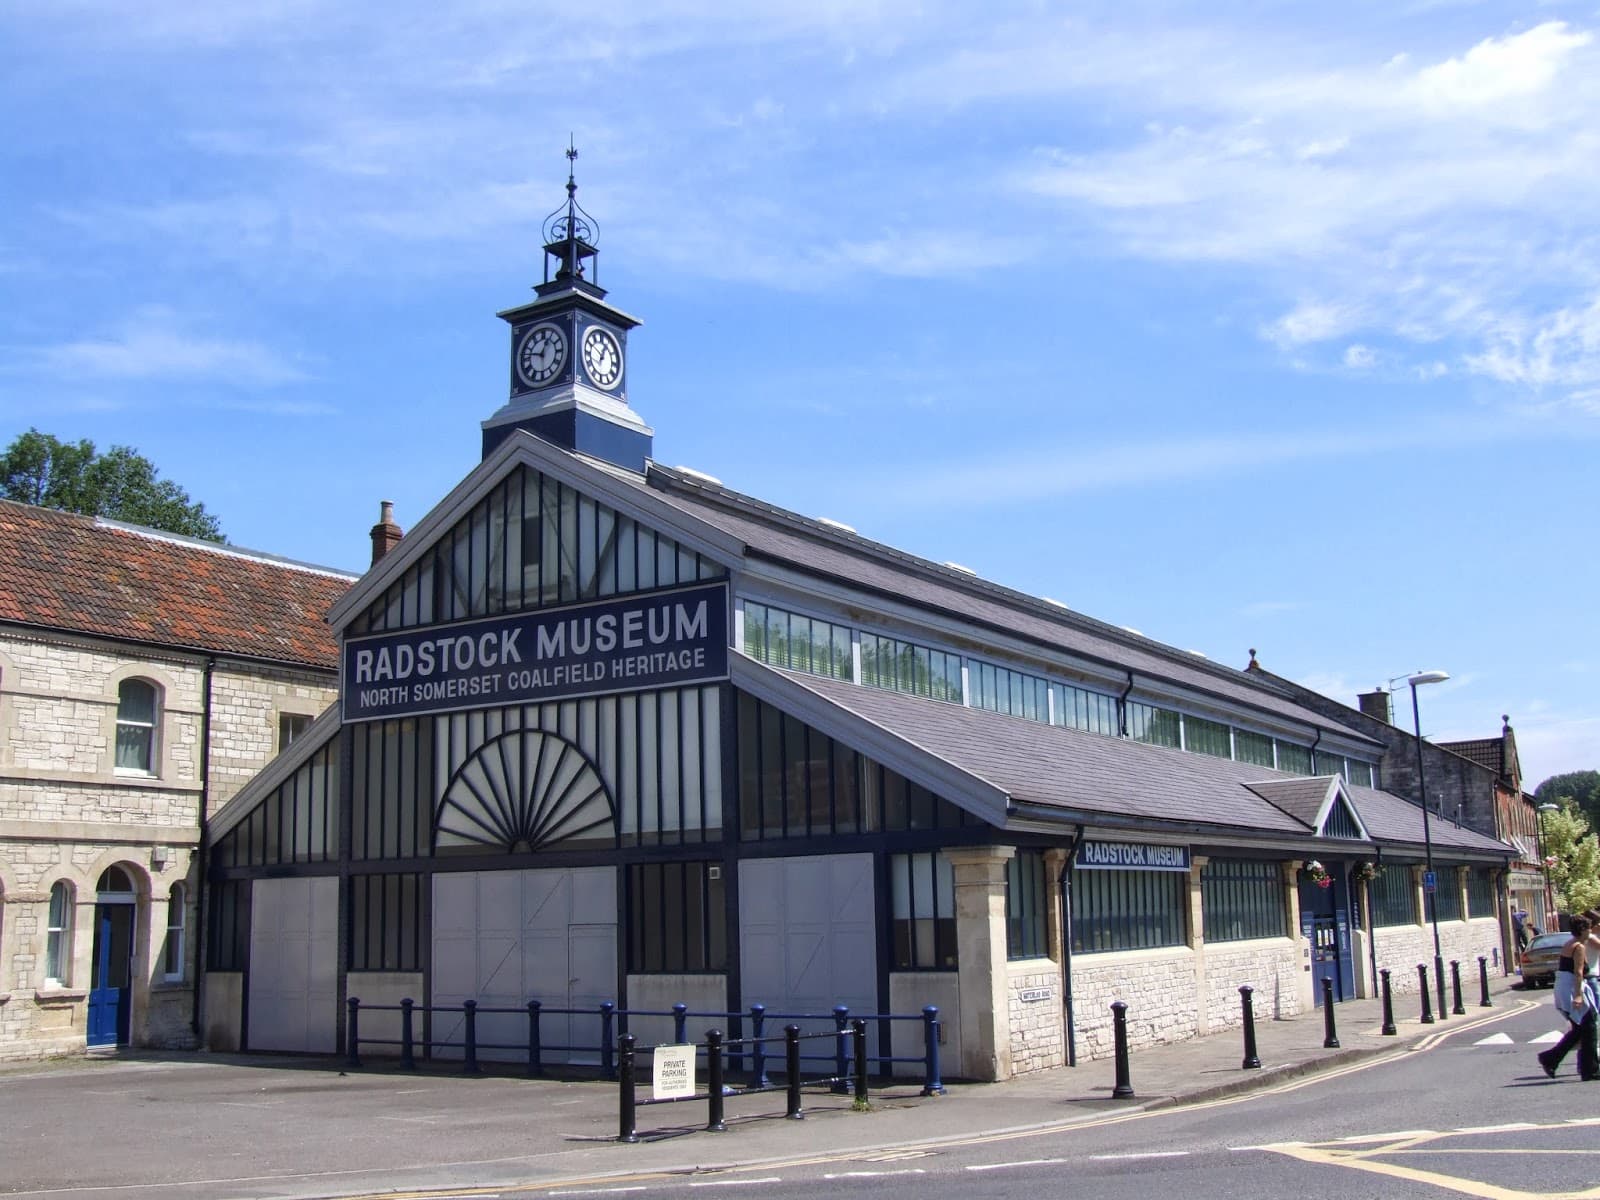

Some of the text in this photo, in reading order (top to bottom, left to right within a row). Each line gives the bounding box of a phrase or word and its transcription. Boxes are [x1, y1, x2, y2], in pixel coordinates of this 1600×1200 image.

[356, 600, 708, 683] RADSTOCK MUSEUM
[360, 648, 705, 708] NORTH SOMERSET COALFIELD HERITAGE
[1085, 842, 1184, 867] RADSTOCK MUSEUM
[661, 1069, 687, 1078] PARKING
[663, 1060, 686, 1069] PRIVATE
